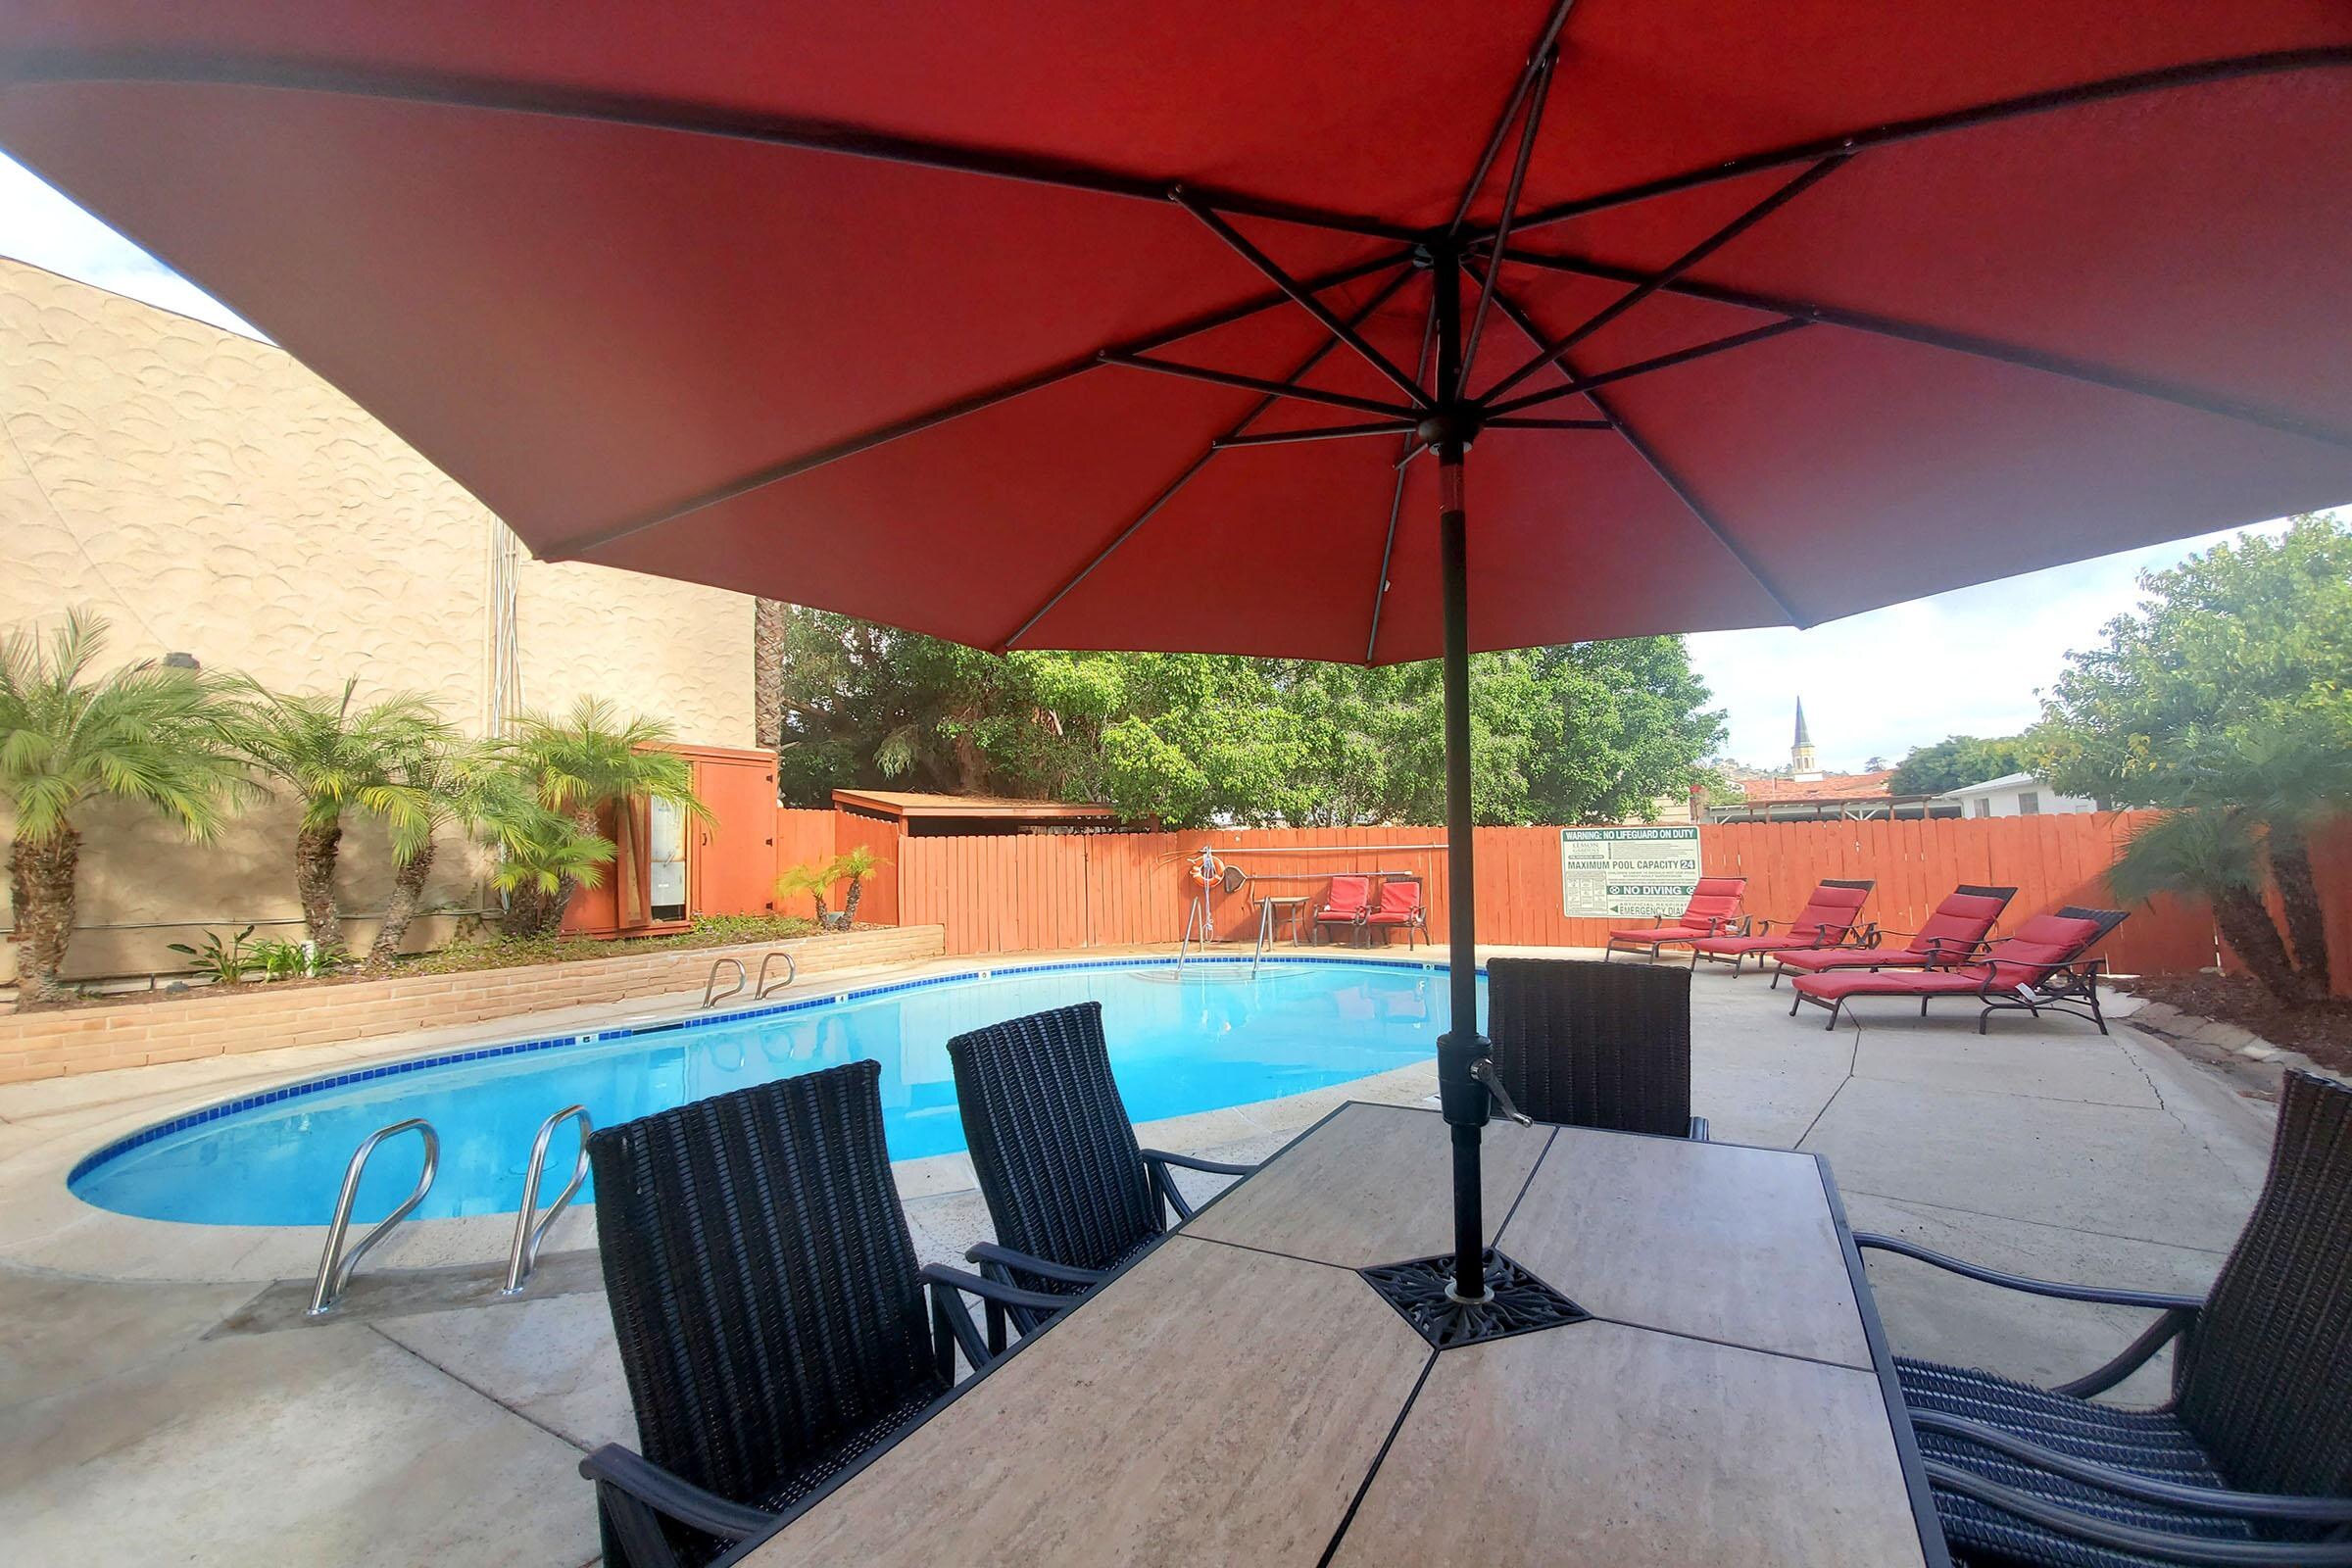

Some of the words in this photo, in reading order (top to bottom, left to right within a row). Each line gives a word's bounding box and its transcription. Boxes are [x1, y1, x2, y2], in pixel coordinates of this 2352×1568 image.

[1565, 831, 1602, 840] WARNING:
[1603, 830, 1615, 839] NO
[1616, 830, 1658, 839] LIFEGUARD
[1660, 830, 1672, 839] ON
[1673, 829, 1693, 838] DUTY
[1568, 860, 1610, 869] MAXIMUM
[1612, 860, 1635, 869] POOL
[1637, 860, 1679, 869] CAPACITY
[1682, 860, 1693, 869] 24
[1623, 886, 1640, 895] NO
[1642, 886, 1682, 895] DIVING
